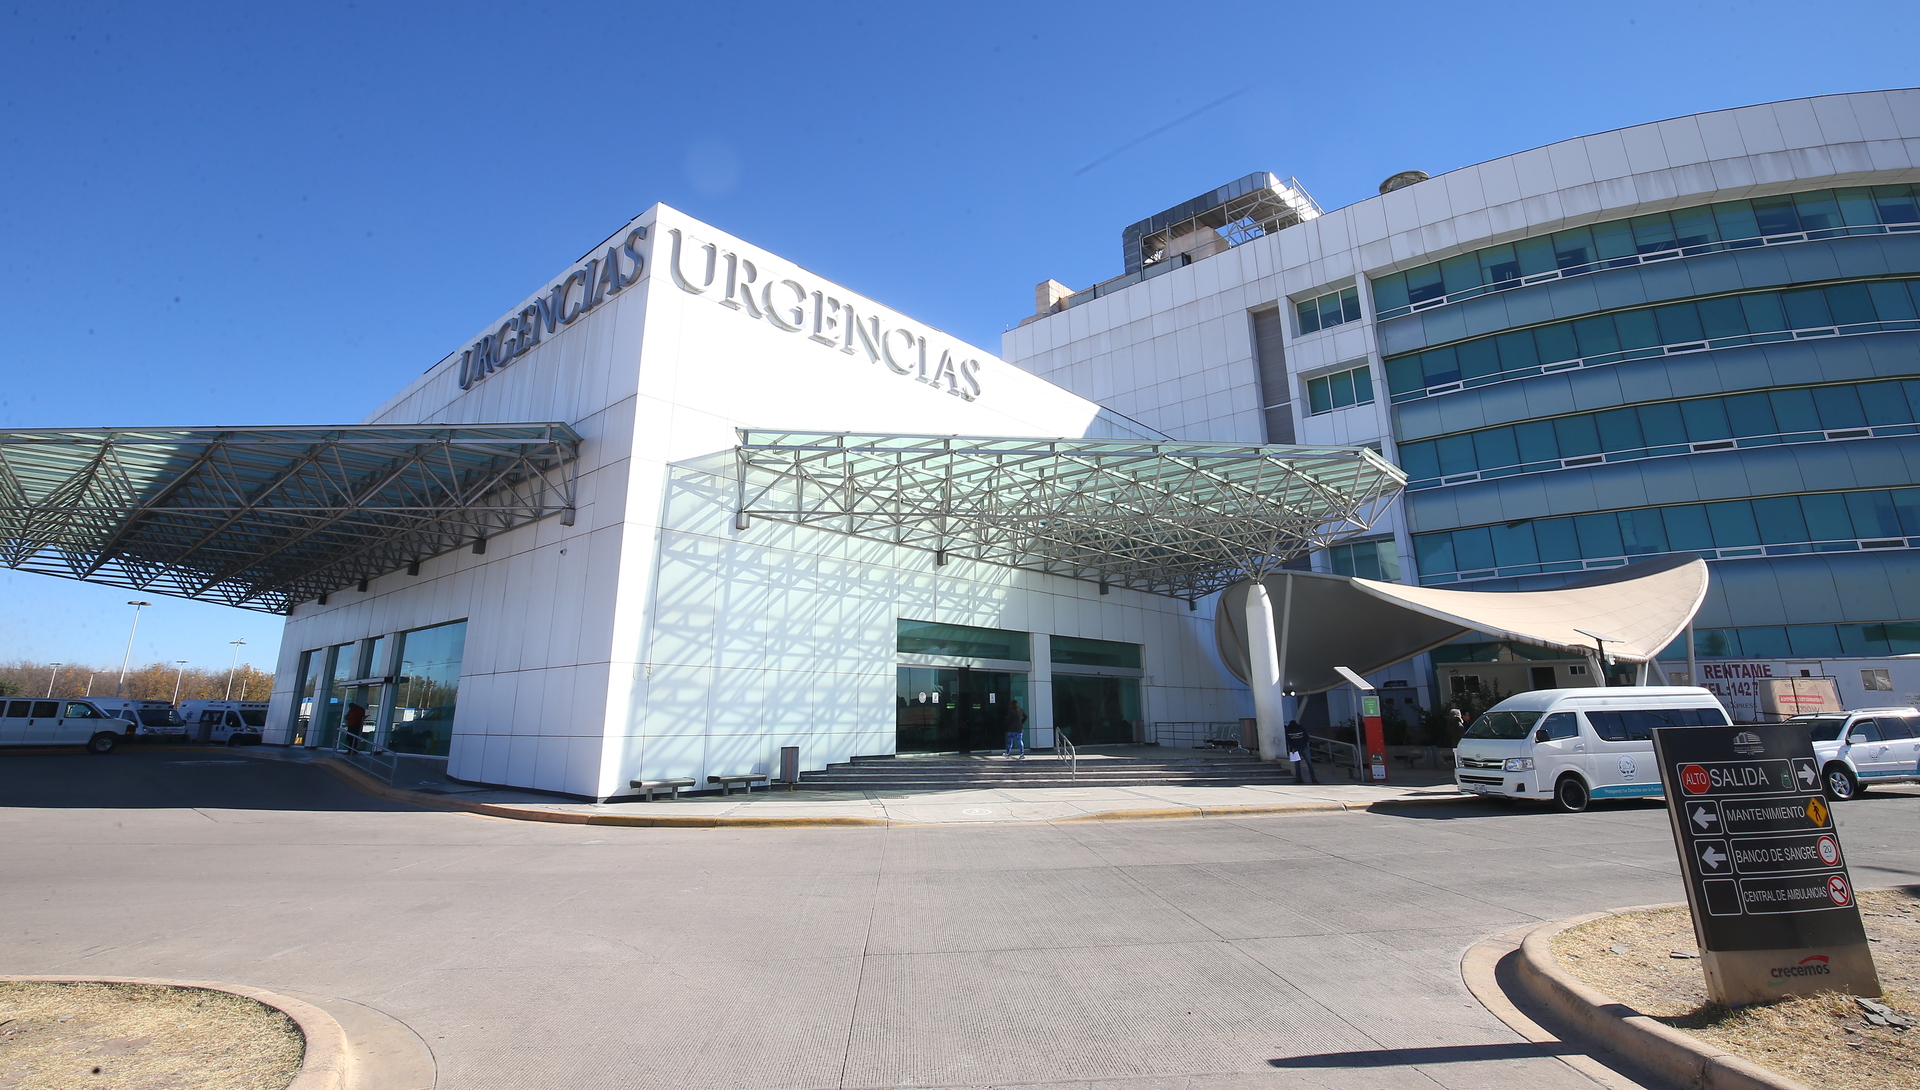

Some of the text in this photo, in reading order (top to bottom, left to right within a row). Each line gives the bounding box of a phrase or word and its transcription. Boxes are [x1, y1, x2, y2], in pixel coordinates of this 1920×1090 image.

[458, 226, 647, 390] URGENCIAS
[667, 228, 981, 402] URGENCIAS
[1703, 664, 1772, 679] RENTAME
[1686, 772, 1706, 785] ALTO
[1709, 767, 1770, 787] SALIDA
[1726, 805, 1805, 821] MANTENIMIENTO
[1735, 846, 1818, 863] BANCO DE SANGRE
[1823, 845, 1832, 854] 20
[1743, 886, 1828, 902] CENTRAL DE AMBULANCIAS
[1771, 964, 1830, 978] crecemos
